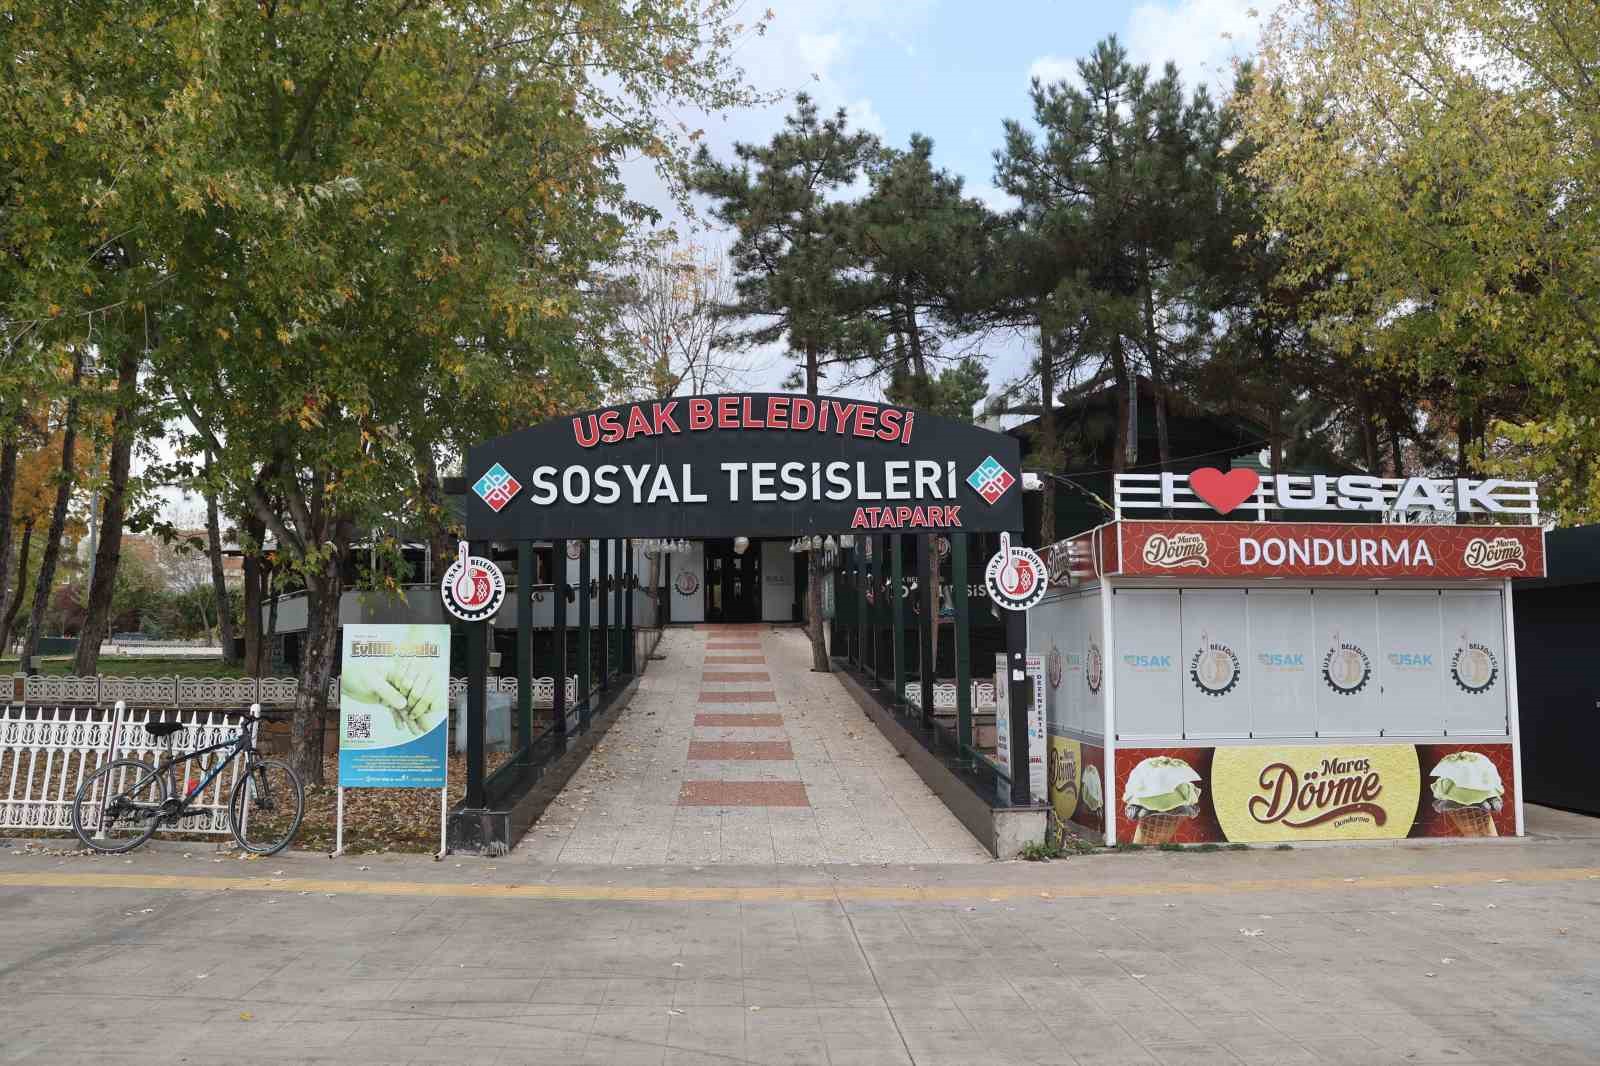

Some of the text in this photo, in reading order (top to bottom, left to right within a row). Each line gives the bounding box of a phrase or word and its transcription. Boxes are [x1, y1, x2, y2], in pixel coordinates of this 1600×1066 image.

[530, 463, 708, 505] SOSYAL
[850, 505, 962, 529] ATAPARK
[1239, 537, 1435, 567] DONDURMA
[1321, 757, 1371, 775] Maraş
[1249, 763, 1383, 824] Dövme
